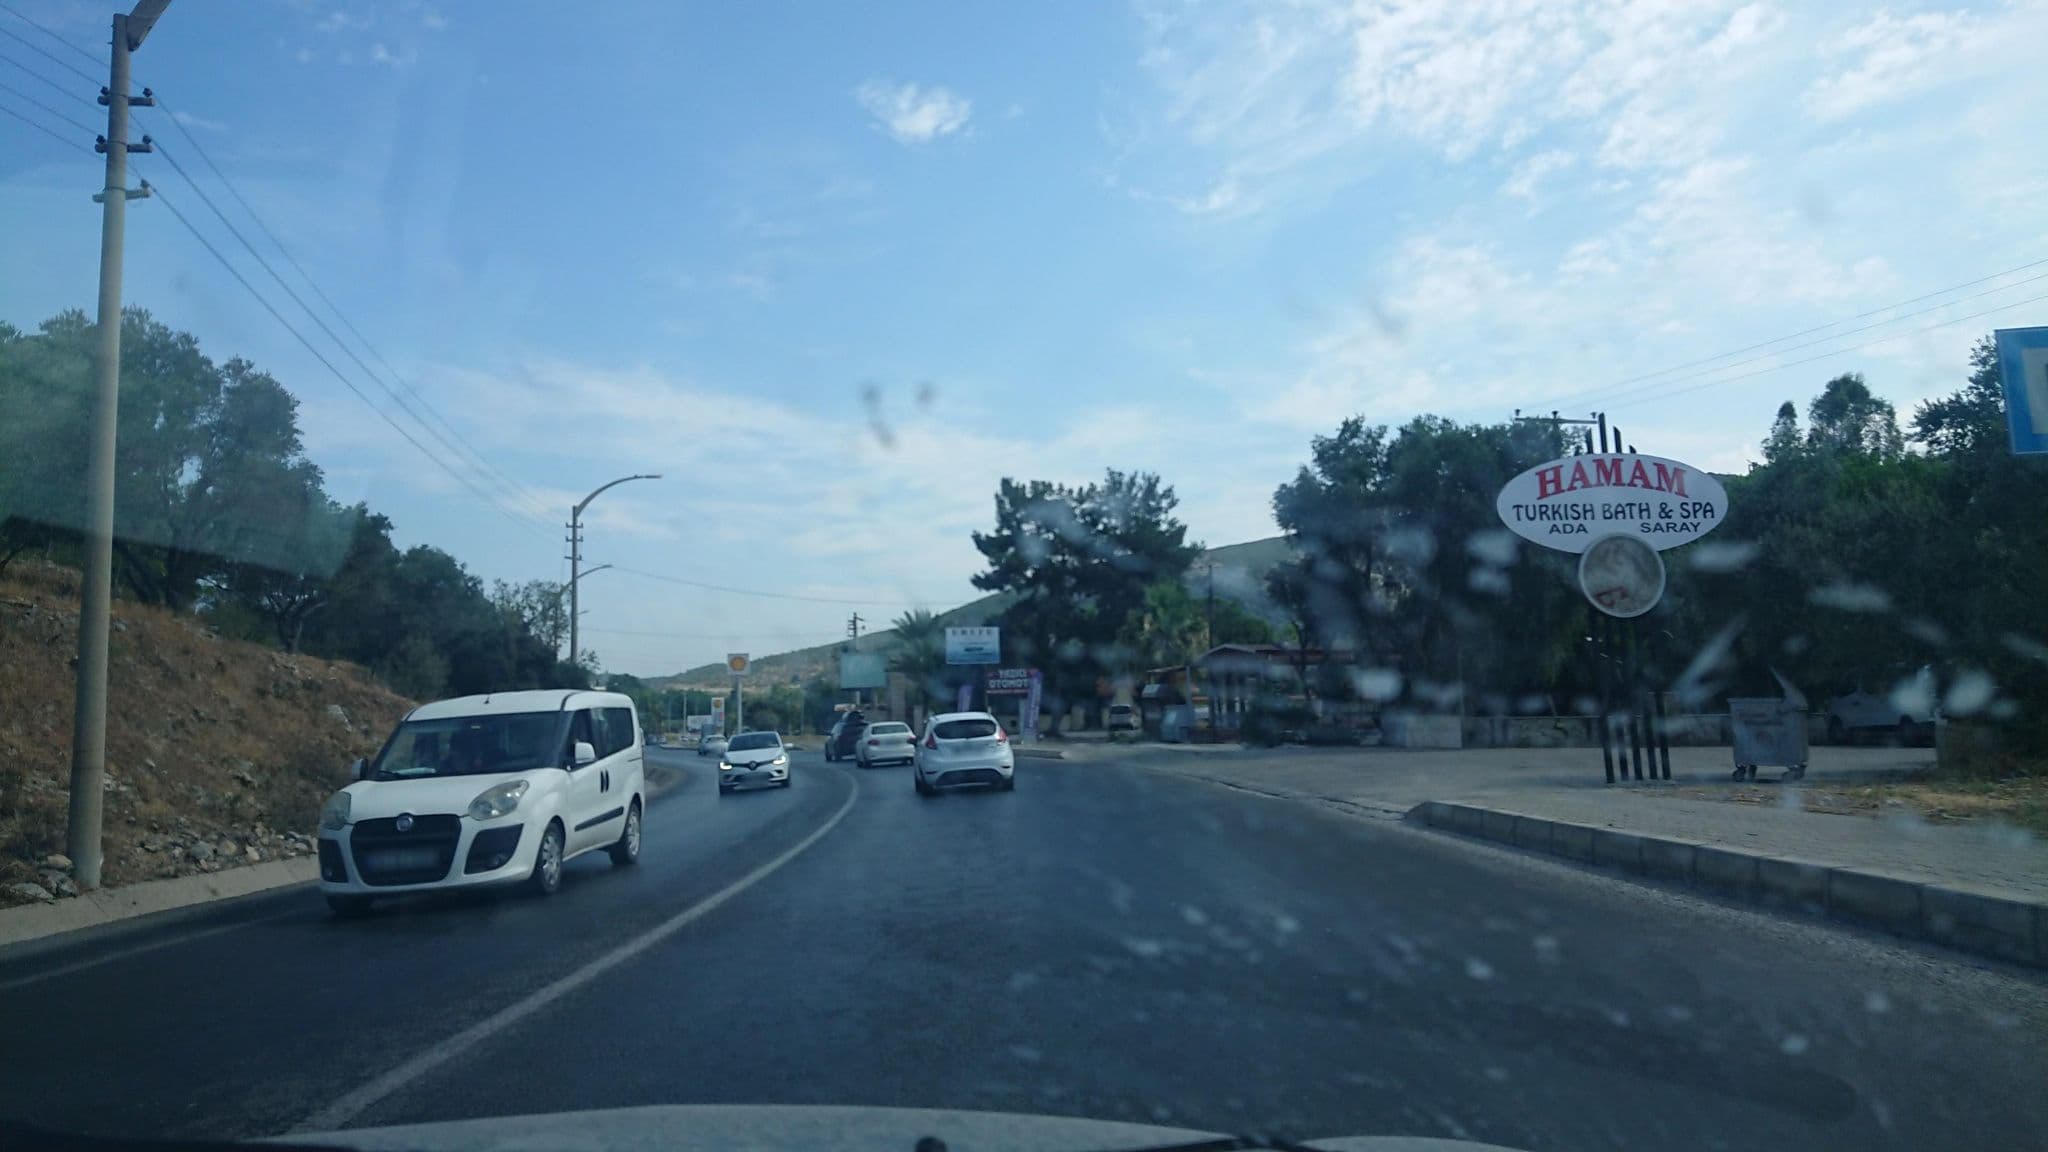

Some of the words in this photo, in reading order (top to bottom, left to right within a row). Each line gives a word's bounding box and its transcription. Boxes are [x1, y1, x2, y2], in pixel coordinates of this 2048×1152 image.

[1535, 458, 1689, 500] HAMAM
[1512, 504, 1595, 521] TURKISH
[1602, 503, 1651, 520] BATH
[1658, 502, 1673, 519] &
[1680, 502, 1715, 519] SPA
[1549, 523, 1588, 534] ADA
[1640, 522, 1701, 533] SARAY
